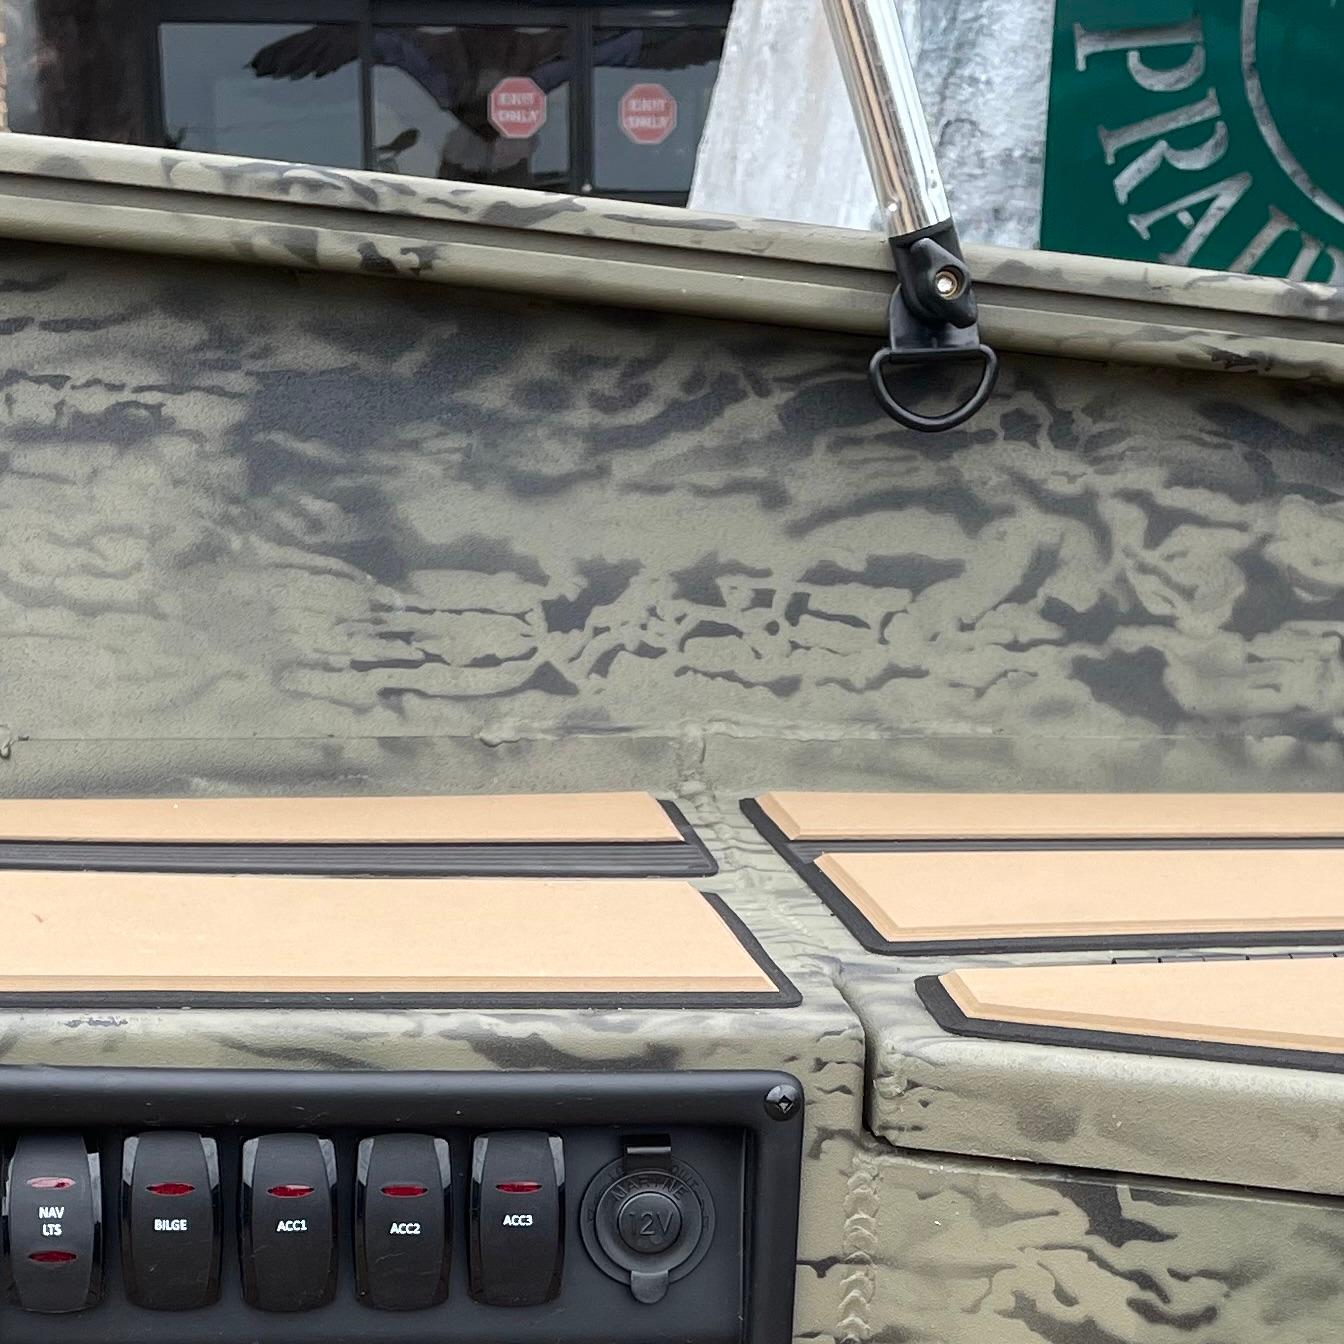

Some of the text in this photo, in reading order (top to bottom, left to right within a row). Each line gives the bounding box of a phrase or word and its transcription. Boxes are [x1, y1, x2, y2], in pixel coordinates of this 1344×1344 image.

[39, 1207, 64, 1218] NAV
[154, 1219, 187, 1230] BILGE
[276, 1220, 307, 1232] ACC1
[503, 1214, 534, 1227] ACC3
[628, 1210, 674, 1236] 12V
[42, 1223, 62, 1236] LTS
[390, 1222, 421, 1235] ACC2
